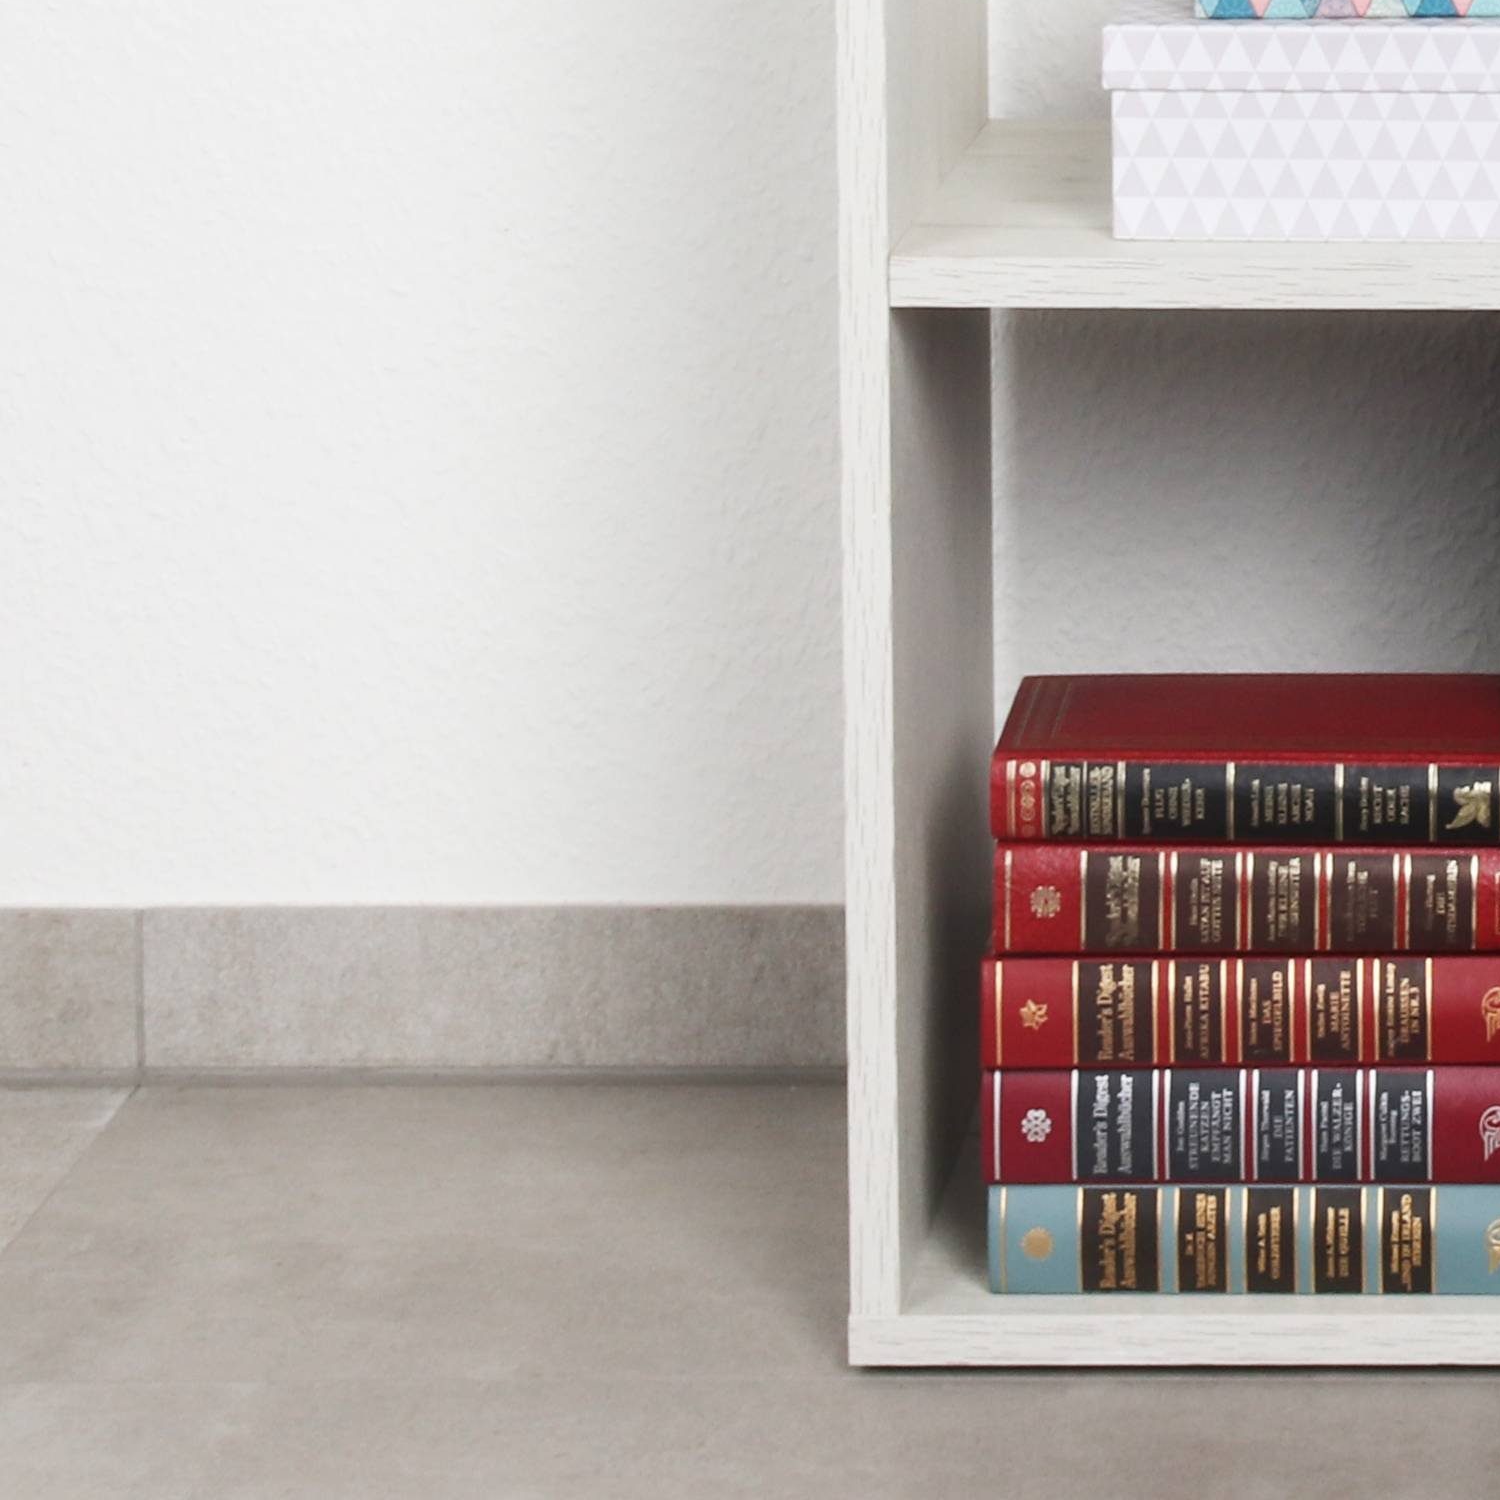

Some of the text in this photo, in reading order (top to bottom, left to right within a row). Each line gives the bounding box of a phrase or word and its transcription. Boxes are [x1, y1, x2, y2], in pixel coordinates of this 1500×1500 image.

[1093, 1075, 1110, 1118] Digest
[1201, 1101, 1209, 1152] KATZEN
[1223, 1089, 1233, 1164] MAN NICHT
[1274, 1116, 1282, 1137] DIE
